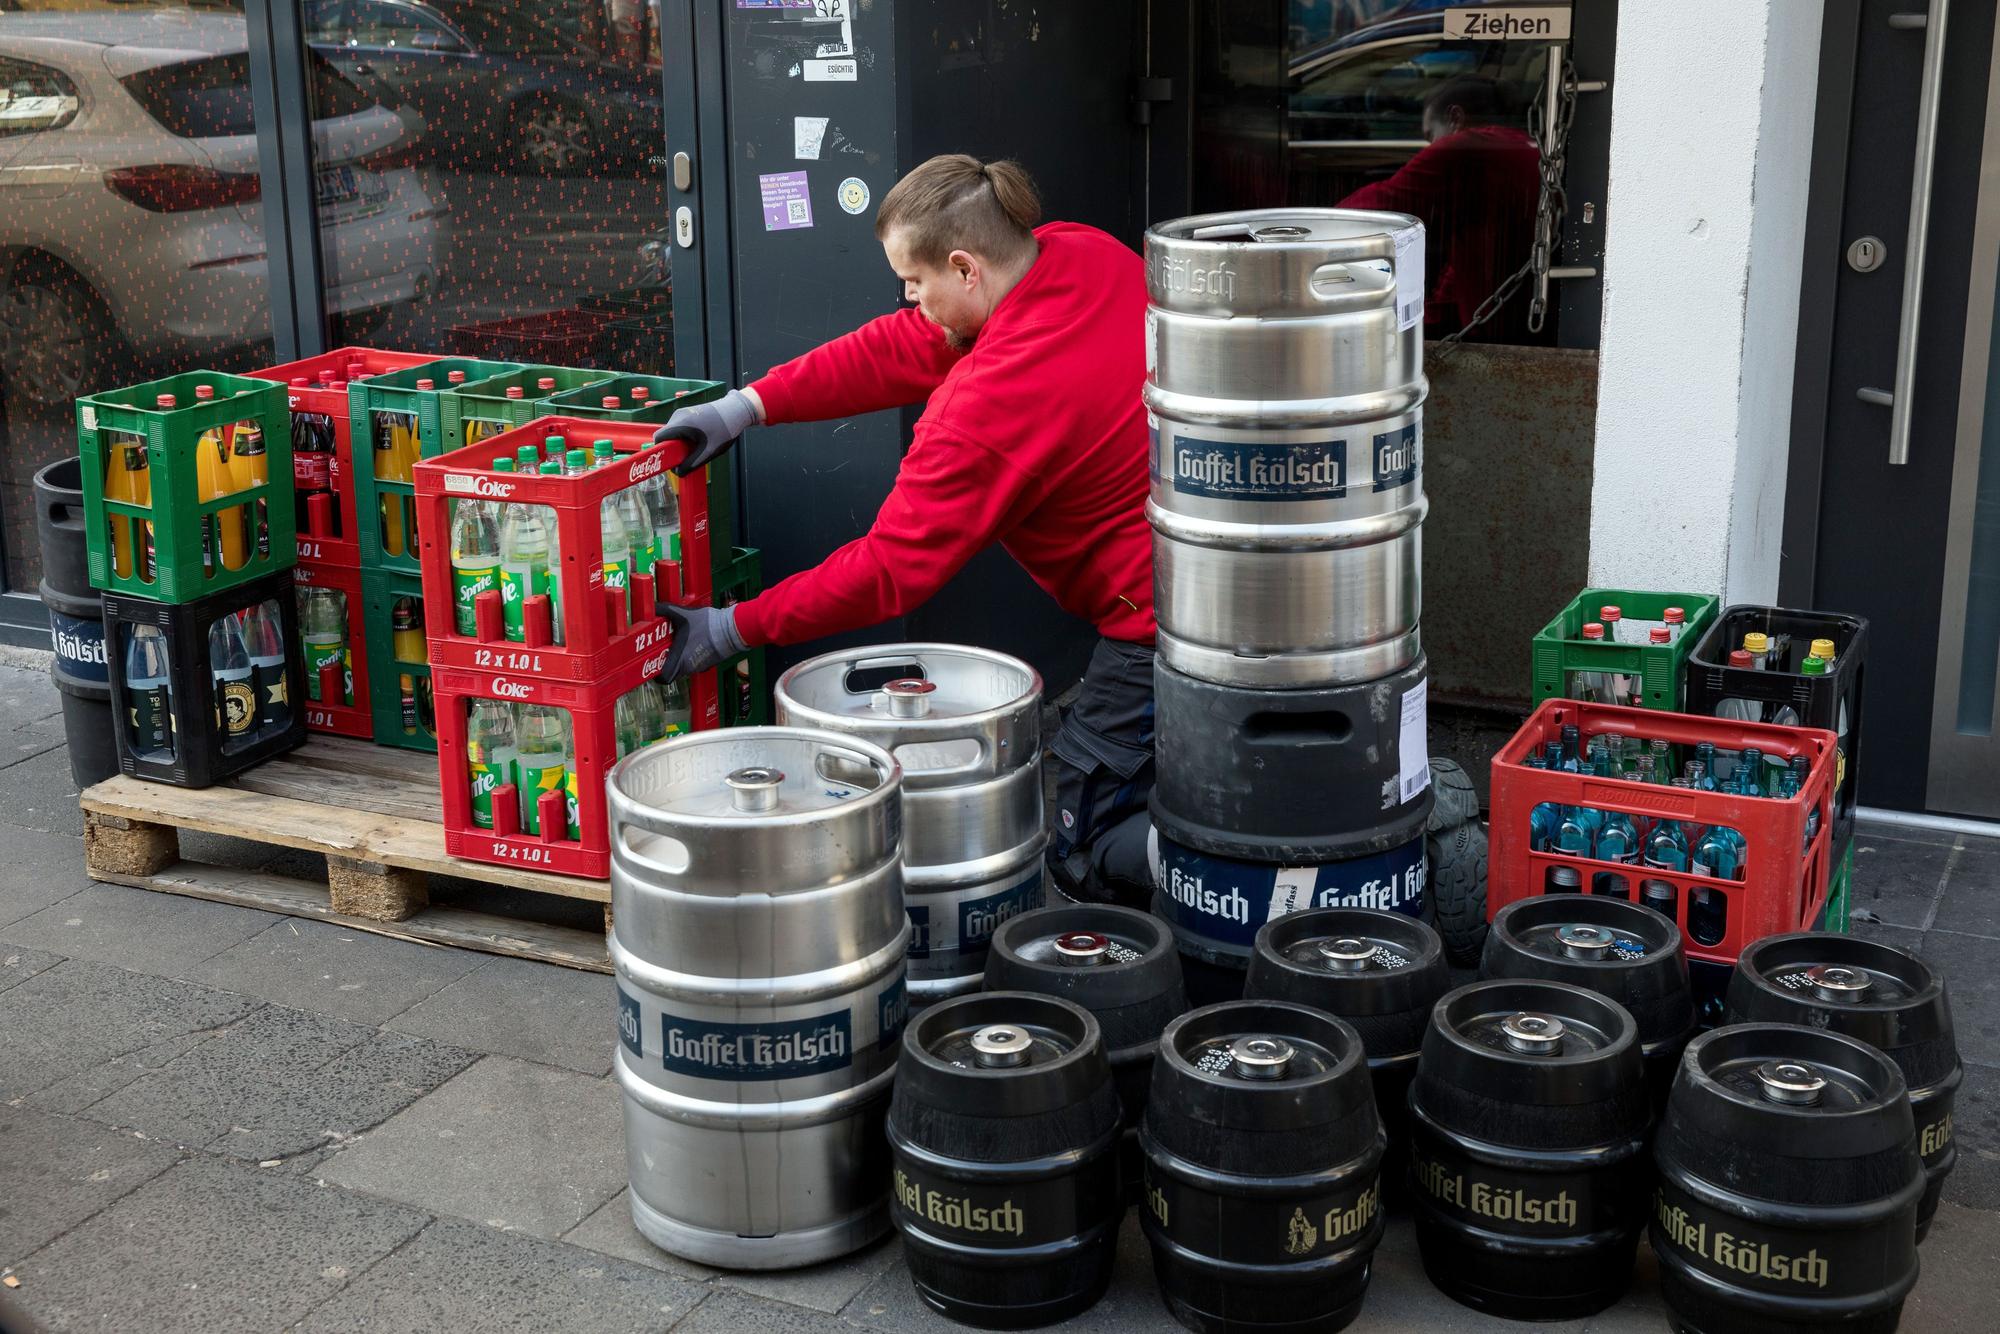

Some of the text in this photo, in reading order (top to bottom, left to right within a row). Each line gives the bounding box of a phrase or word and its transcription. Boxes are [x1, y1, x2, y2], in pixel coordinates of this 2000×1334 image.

[1463, 13, 1550, 34] Ziehen
[1161, 255, 1237, 302] Kölsch
[629, 449, 663, 482] Coca-Cola
[1178, 449, 1339, 487] Gaffel Kölsch
[314, 544, 322, 558] L
[635, 635, 646, 652] 12
[647, 633, 653, 646] x
[654, 624, 668, 644] 1.0
[474, 650, 542, 672] 12 x 1.0 L
[326, 713, 334, 727] L
[493, 843, 552, 864] 12 x 1.0 L
[1171, 867, 1249, 926] Kölsch
[668, 1024, 846, 1066] Gaffel Kölsch
[926, 1190, 1023, 1237] Kölsch
[1471, 1182, 1577, 1228] Kölsch
[1713, 1231, 1828, 1288] Kölsch
